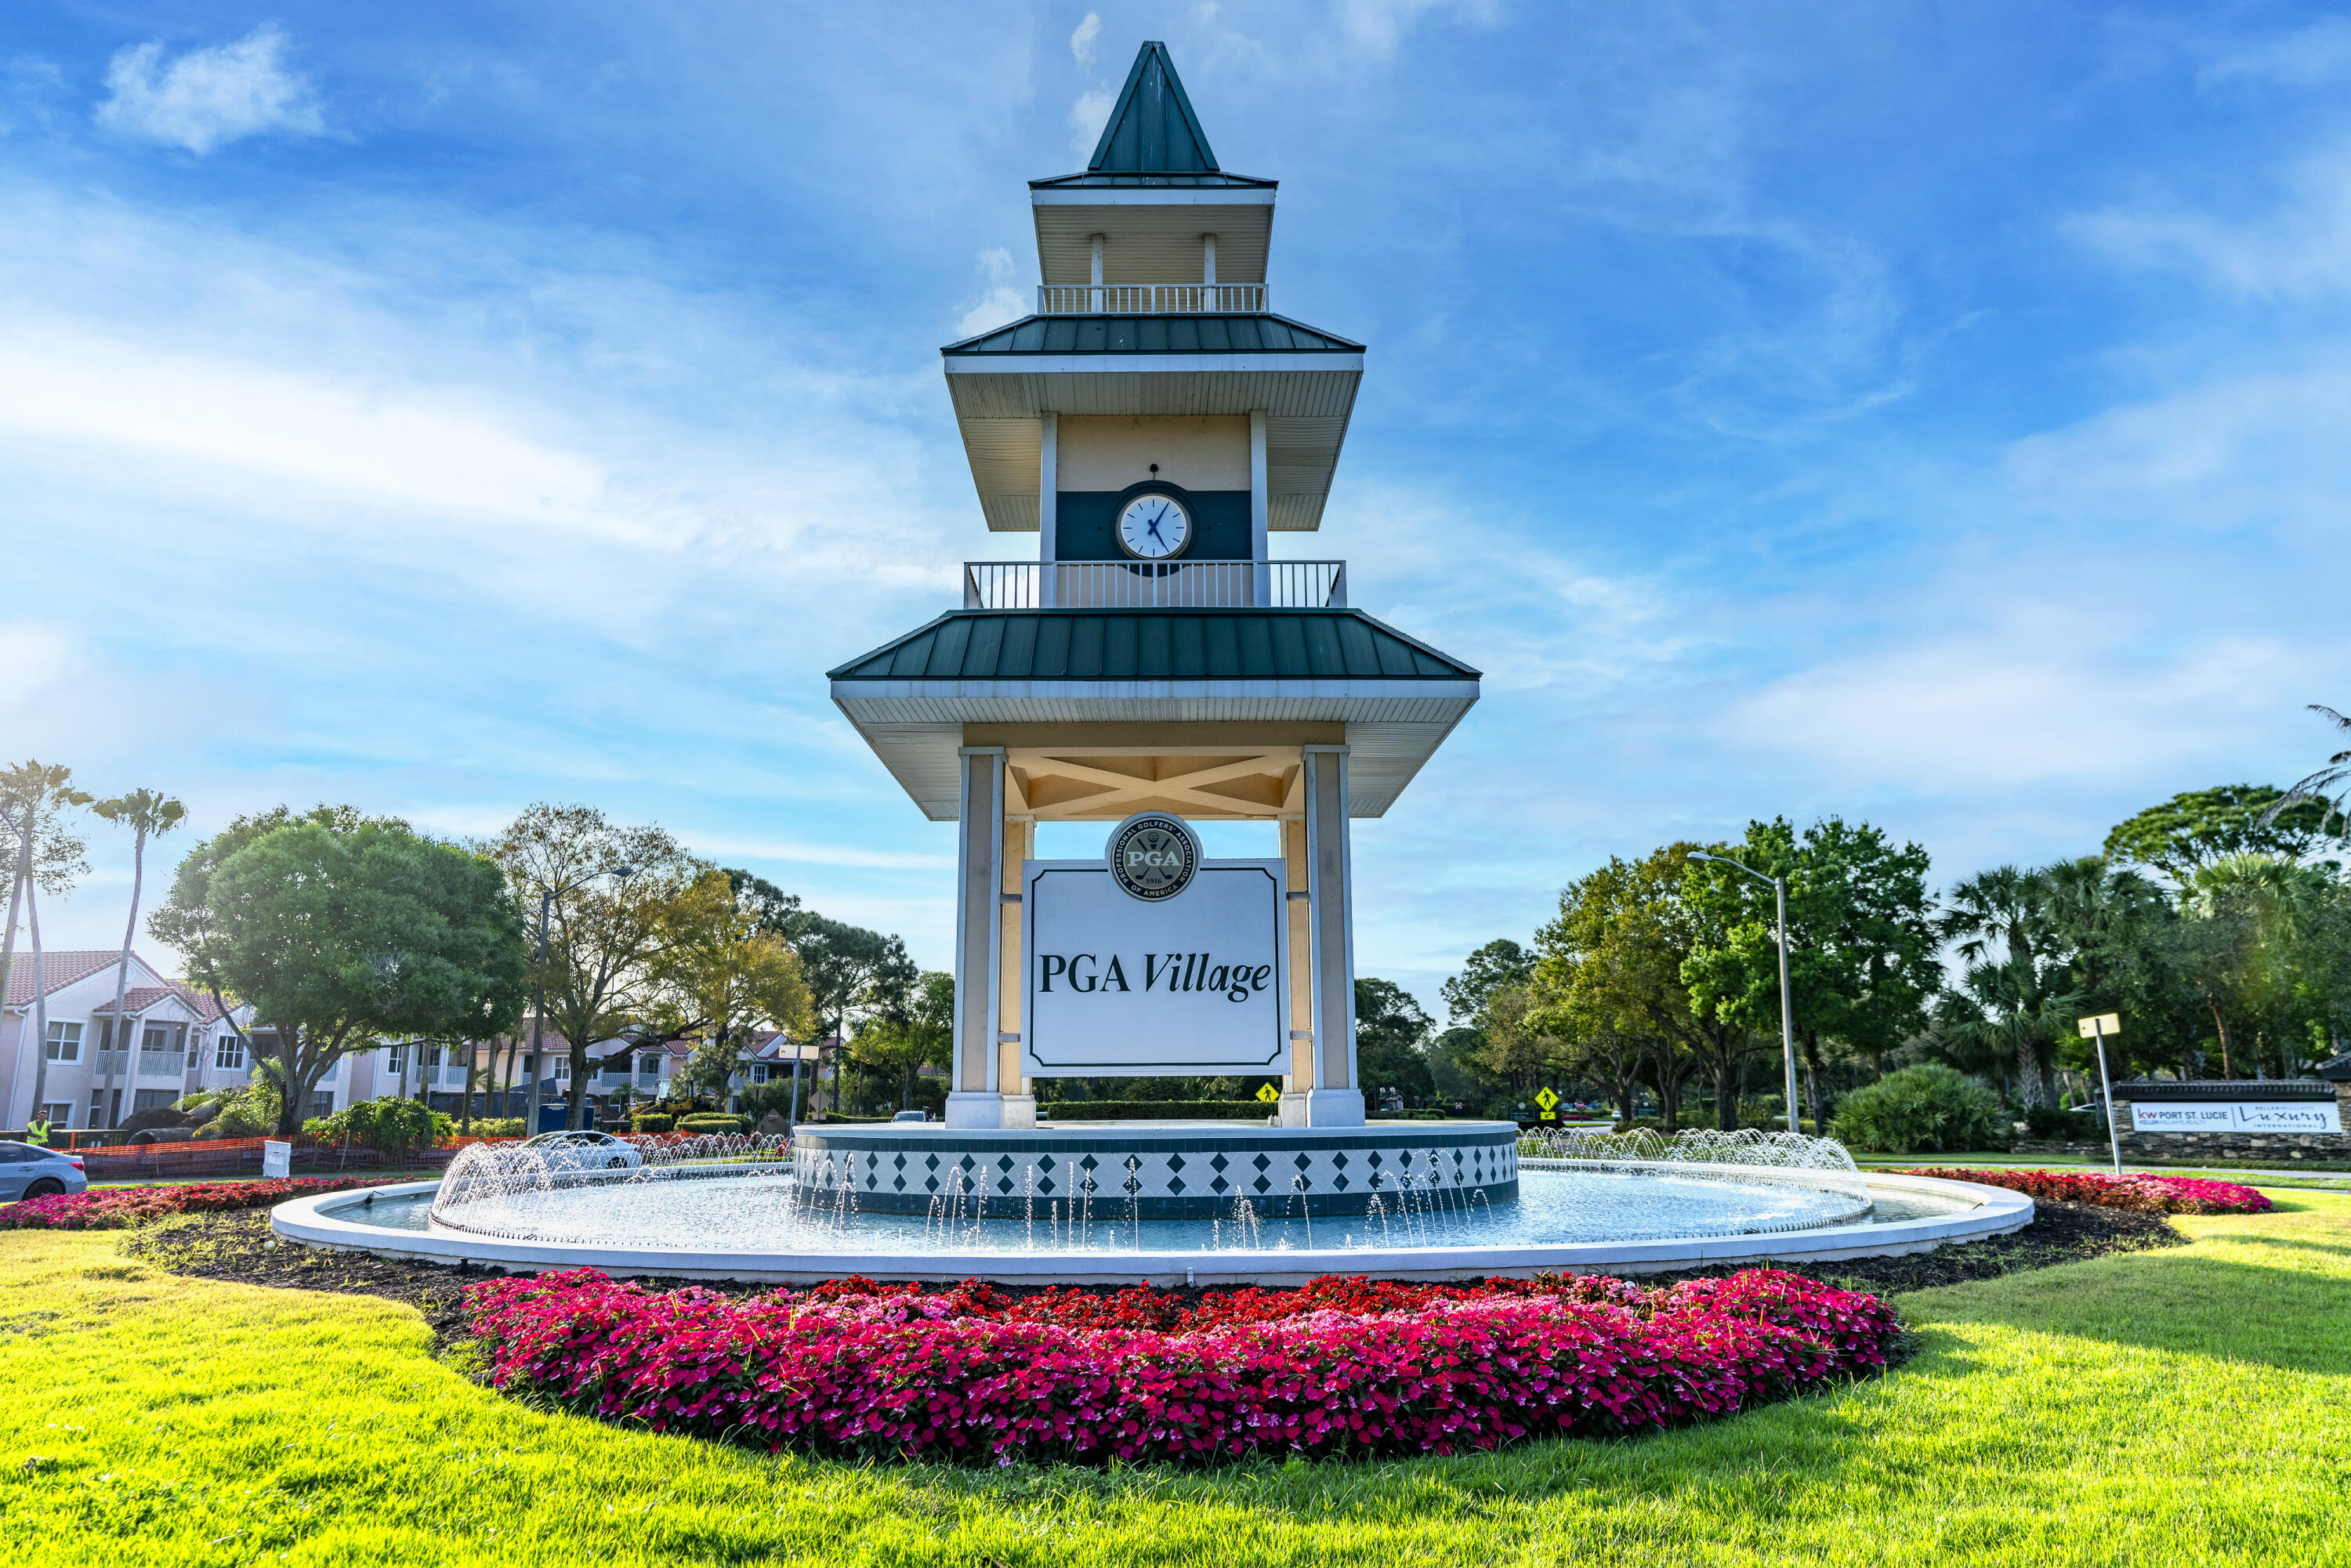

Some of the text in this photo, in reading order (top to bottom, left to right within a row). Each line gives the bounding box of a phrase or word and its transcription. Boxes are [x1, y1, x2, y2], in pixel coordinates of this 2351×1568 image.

[1116, 828, 1136, 883] PROFESSIONAL
[1176, 832, 1192, 882] ASSOCIATION
[1127, 851, 1181, 867] PGA
[1143, 884, 1179, 896] AMERICA
[1038, 952, 1271, 1003] PGA Village
[2159, 1111, 2183, 1120] PORT
[2185, 1111, 2199, 1120] ST.
[2201, 1111, 2228, 1120] LUCIE
[2239, 1106, 2332, 1129] Luxury
